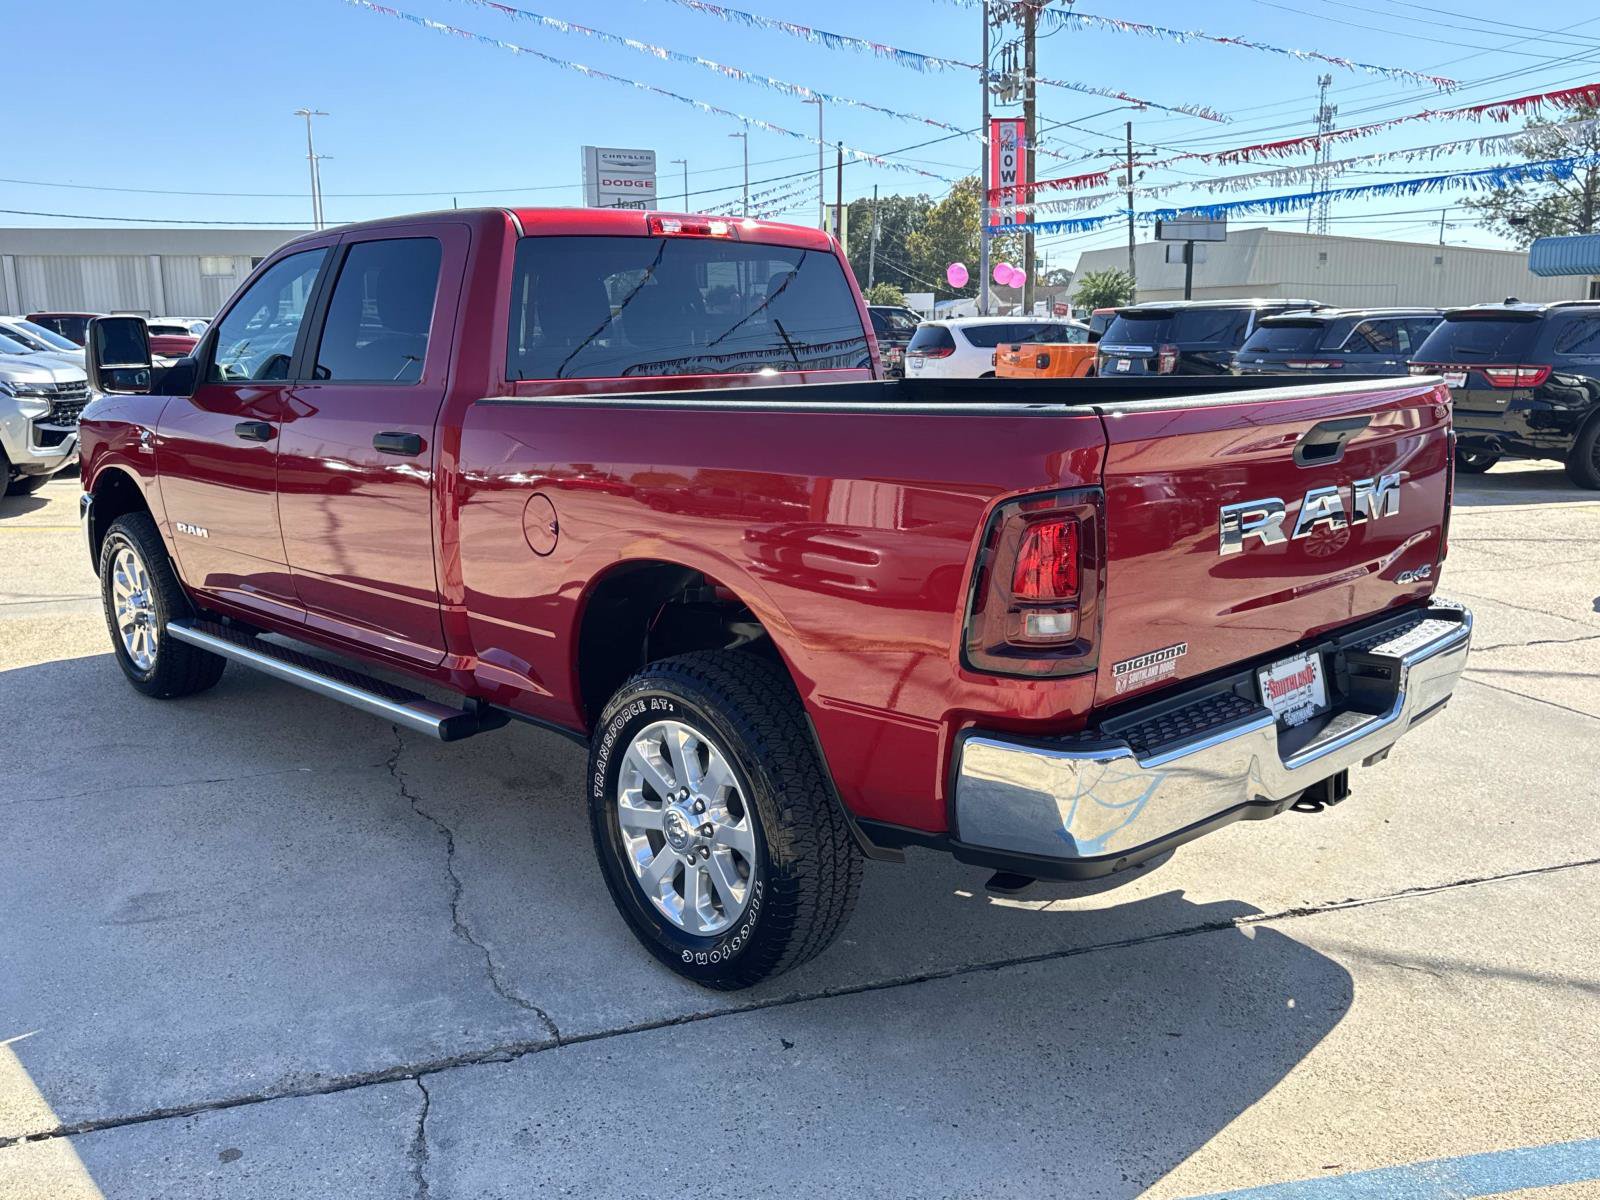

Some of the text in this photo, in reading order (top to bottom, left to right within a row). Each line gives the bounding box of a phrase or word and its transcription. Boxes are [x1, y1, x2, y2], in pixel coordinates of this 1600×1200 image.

[602, 179, 654, 188] DODGE
[177, 522, 209, 538] RAM
[1219, 470, 1409, 556] RAM
[1114, 643, 1187, 677] BIGHORN
[1268, 664, 1314, 699] SOUTHLAND
[594, 700, 647, 798] TRANSFORCE
